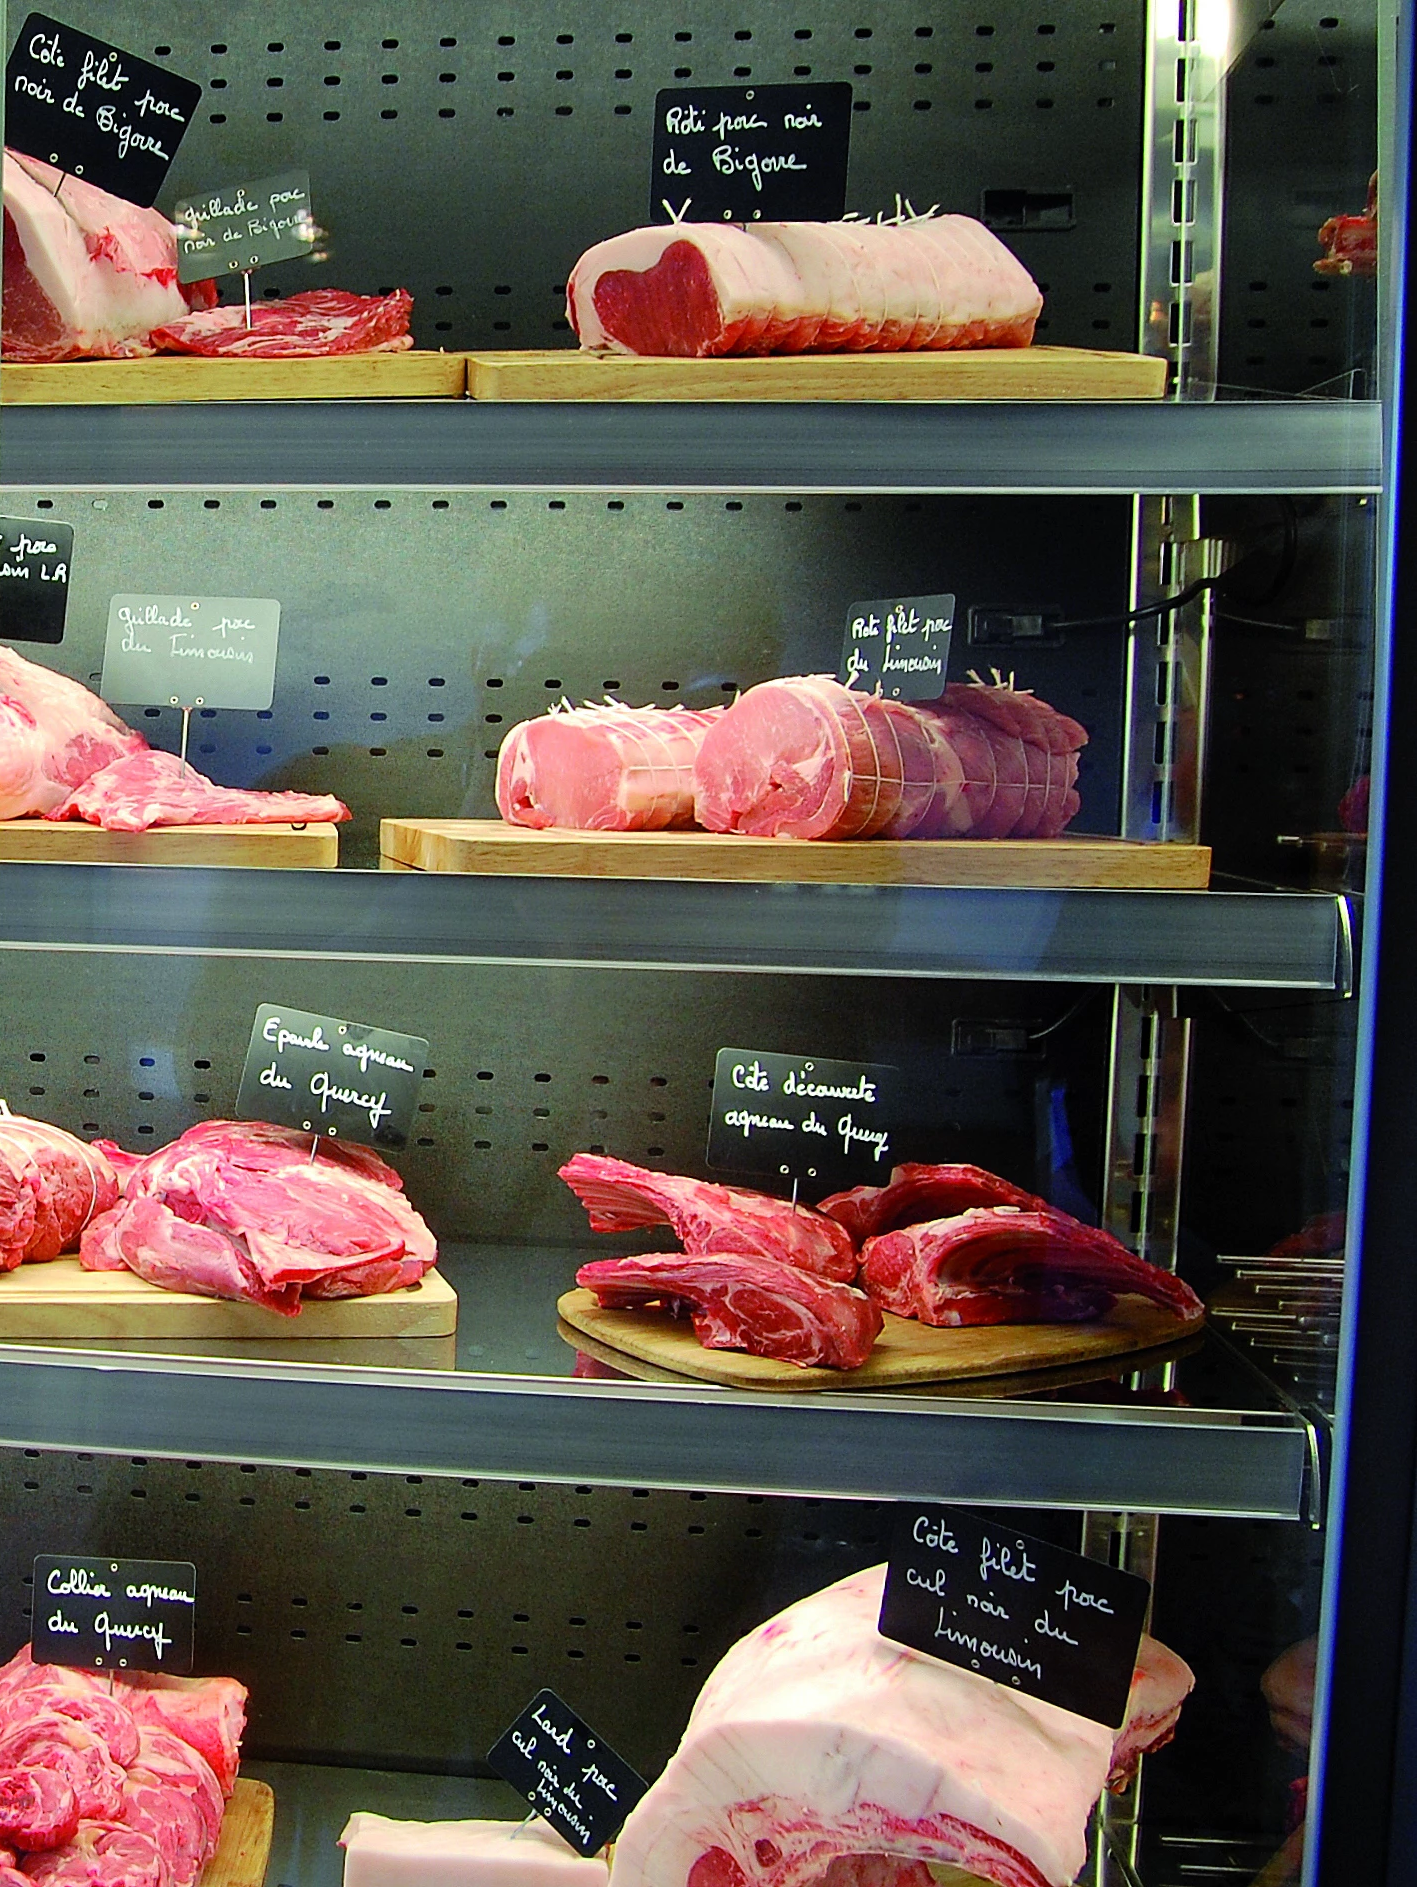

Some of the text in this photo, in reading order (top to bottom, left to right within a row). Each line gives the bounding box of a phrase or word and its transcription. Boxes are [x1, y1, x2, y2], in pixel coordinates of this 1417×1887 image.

[77, 51, 130, 91] filet
[134, 90, 185, 122] porc
[15, 75, 169, 160] noir de Bigorre
[712, 111, 768, 141] porc
[784, 104, 822, 129] noir
[663, 146, 807, 192] de Bigorre
[184, 233, 216, 254] noir
[223, 227, 243, 242] de
[121, 634, 151, 653] du
[885, 607, 920, 643] filet
[847, 648, 869, 672] du
[259, 1061, 292, 1090] du
[342, 1042, 414, 1073] agneau
[725, 1110, 794, 1138] agneau
[801, 1111, 827, 1136] du
[47, 1568, 195, 1608] Collier agneau
[979, 1536, 1036, 1581] filet
[1055, 1579, 1114, 1615] porc
[48, 1609, 79, 1634] du
[906, 1568, 1079, 1646] cul noir du
[934, 1606, 1042, 1680] Limousin
[512, 1731, 582, 1810] cul noir du
[531, 1703, 617, 1802] Lard porc
[536, 1778, 593, 1845] Limousin
